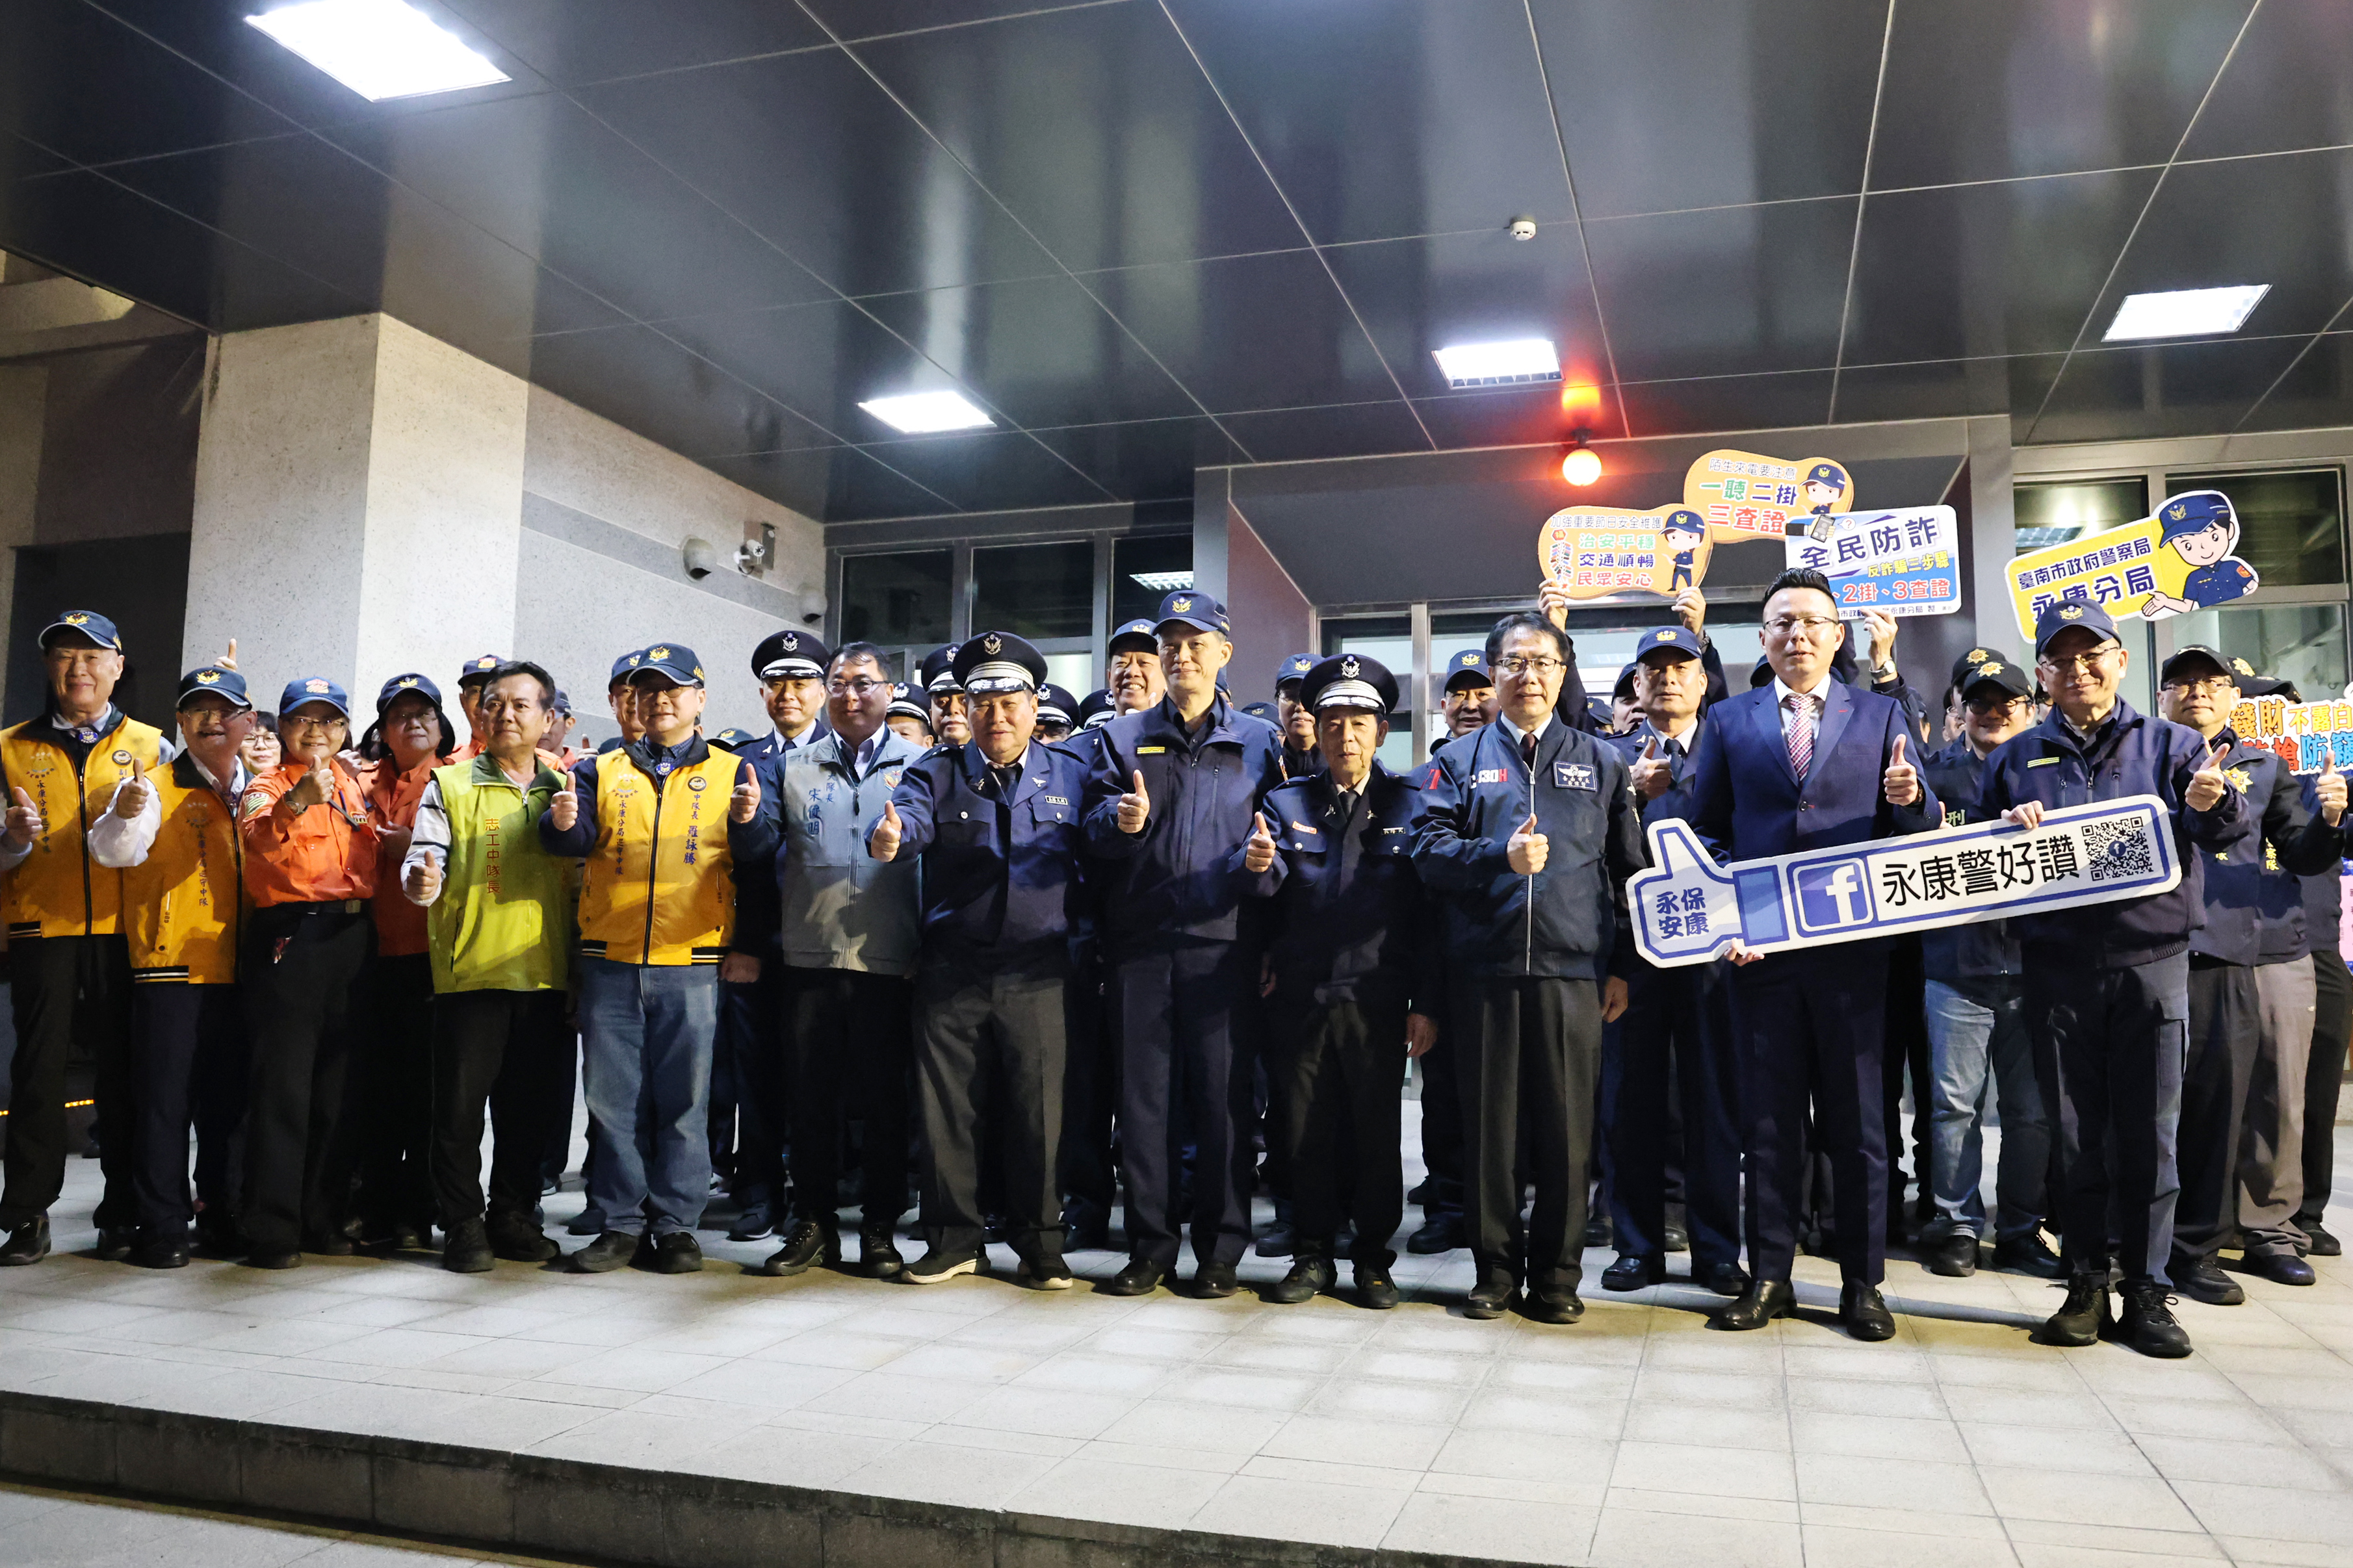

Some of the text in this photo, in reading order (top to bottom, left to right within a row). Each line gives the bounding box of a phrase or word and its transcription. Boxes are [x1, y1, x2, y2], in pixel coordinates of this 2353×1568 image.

[1709, 457, 1797, 480] 陌生來電要注意
[1700, 480, 1798, 506] 一聽二掛
[1551, 515, 1663, 528] 加強重要節日安全維護
[1709, 504, 1787, 534] 三查證
[1579, 533, 1656, 549] 治安平穩
[1800, 516, 1939, 570] 全民防詐
[1579, 553, 1655, 568] 交通順暢
[1867, 550, 1951, 578] 反詐騙三步驟
[2018, 537, 2151, 590] 臺南市政府警察局
[1577, 571, 1652, 587] 民眾安心
[690, 793, 701, 820] 中隊長
[485, 817, 500, 894] 志工中隊長
[1882, 834, 2080, 906] 永康警好讚
